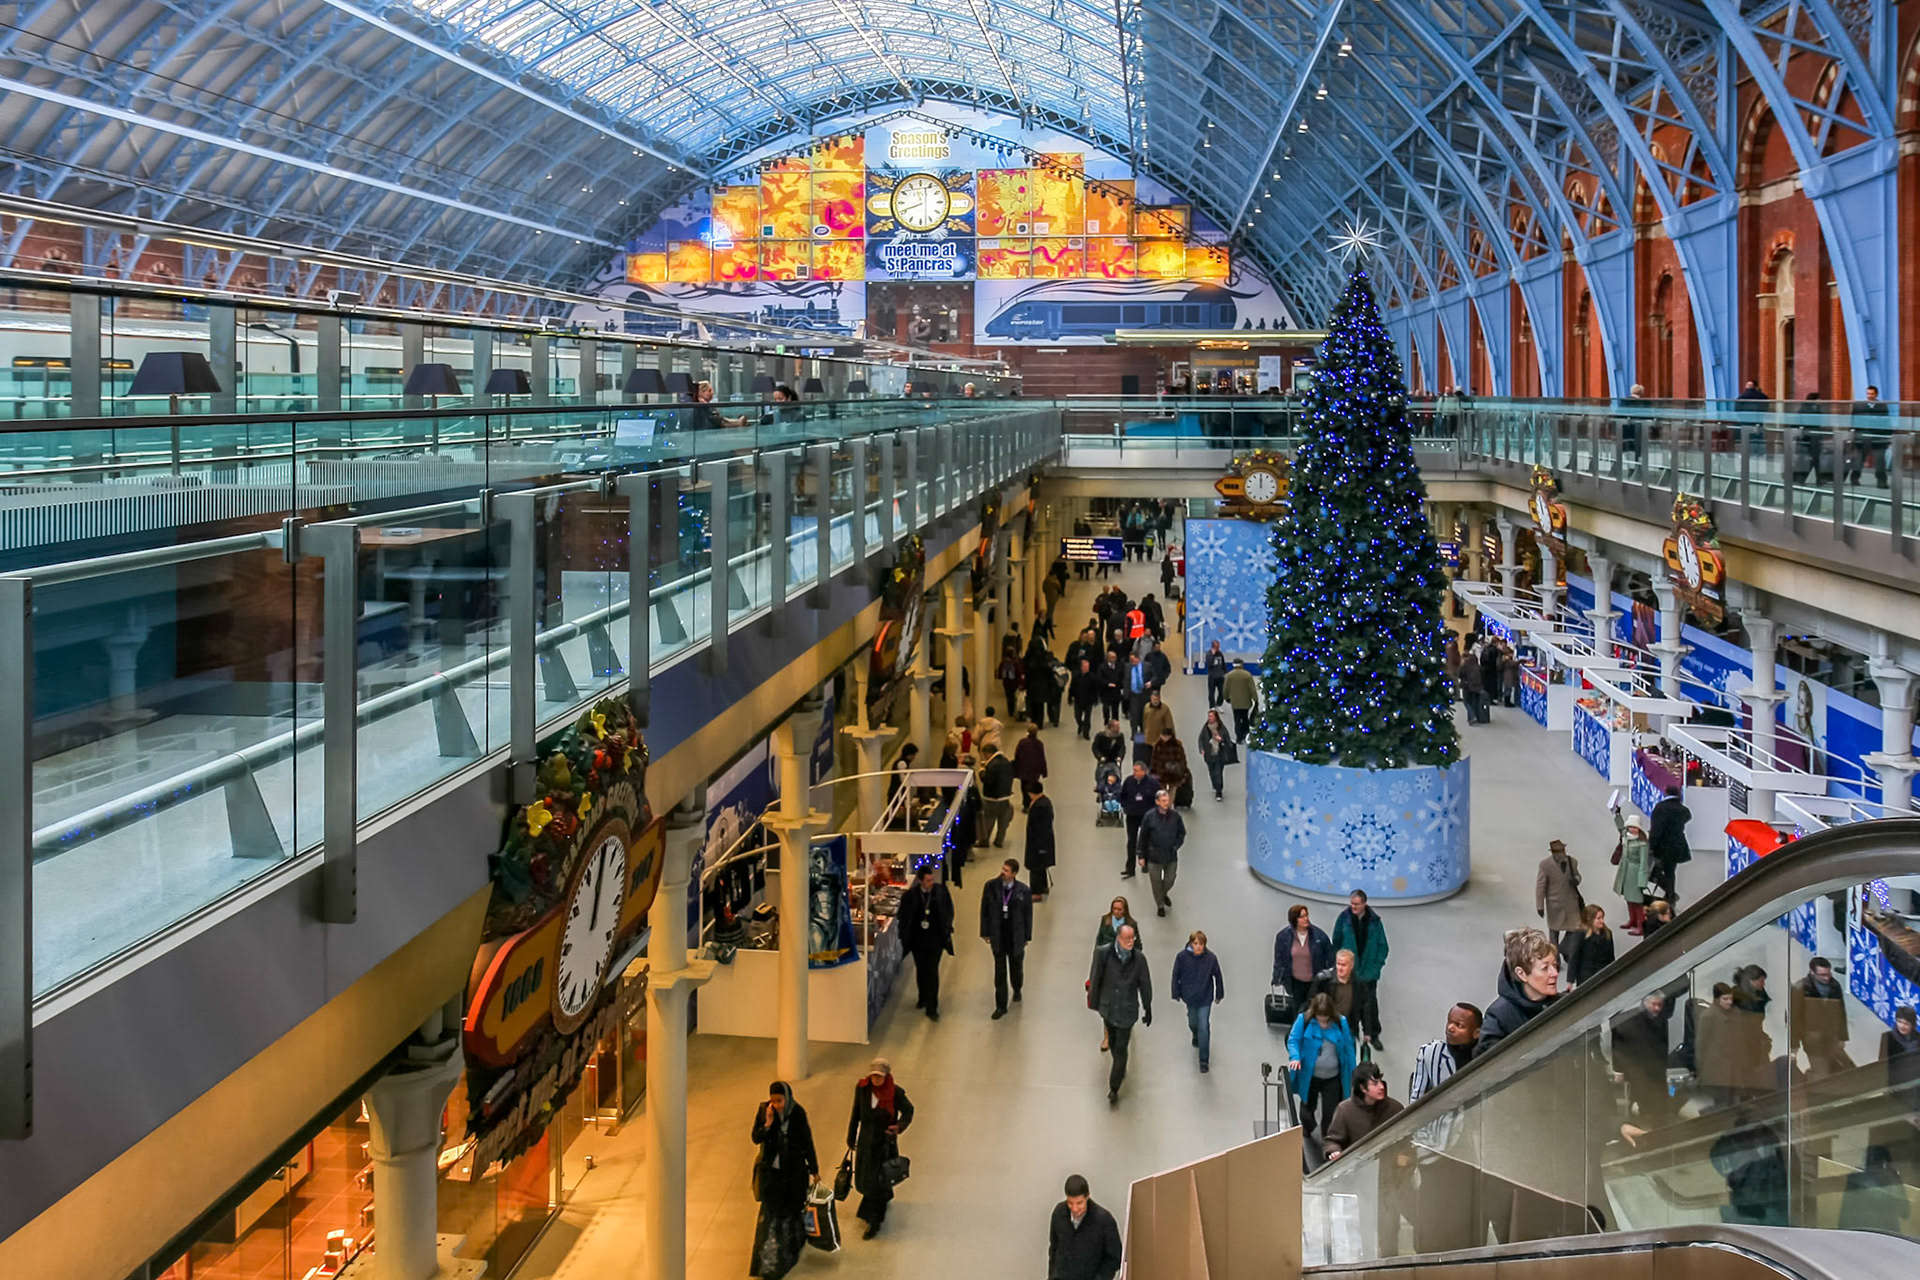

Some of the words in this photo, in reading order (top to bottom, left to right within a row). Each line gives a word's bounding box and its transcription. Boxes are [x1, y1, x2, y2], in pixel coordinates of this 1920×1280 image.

[892, 131, 947, 145] Season's
[890, 145, 949, 159] Greetings
[884, 243, 918, 257] meet
[920, 245, 940, 257] me
[940, 243, 956, 257] at
[900, 257, 953, 271] Pancras
